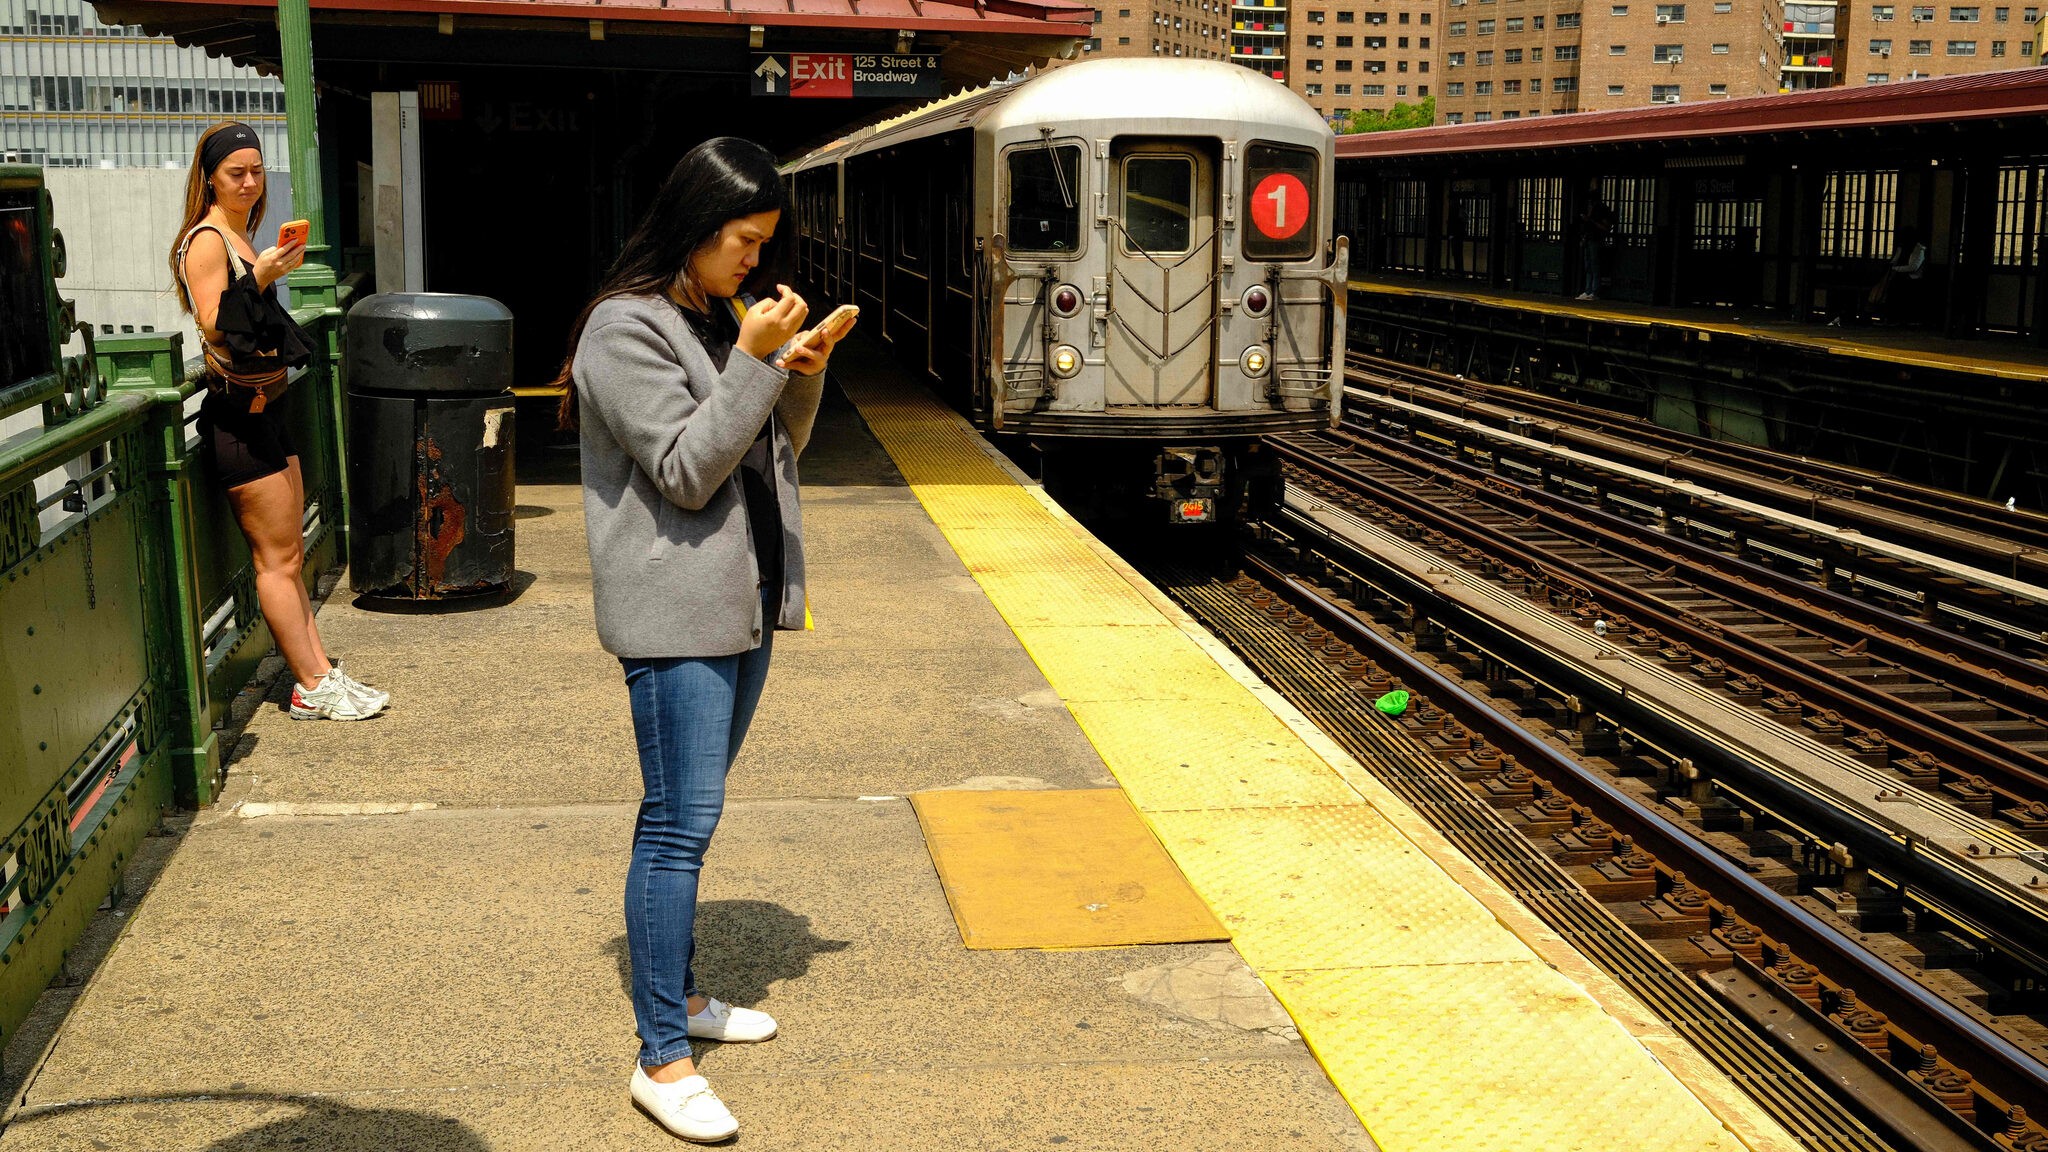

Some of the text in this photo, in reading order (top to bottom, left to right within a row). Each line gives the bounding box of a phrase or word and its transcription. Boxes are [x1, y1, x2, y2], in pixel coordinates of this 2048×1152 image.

[792, 55, 846, 80] Exit
[853, 55, 937, 68] 125 Street &
[853, 70, 918, 84] Broadway
[509, 101, 581, 132] Exit
[1267, 185, 1287, 228] 1
